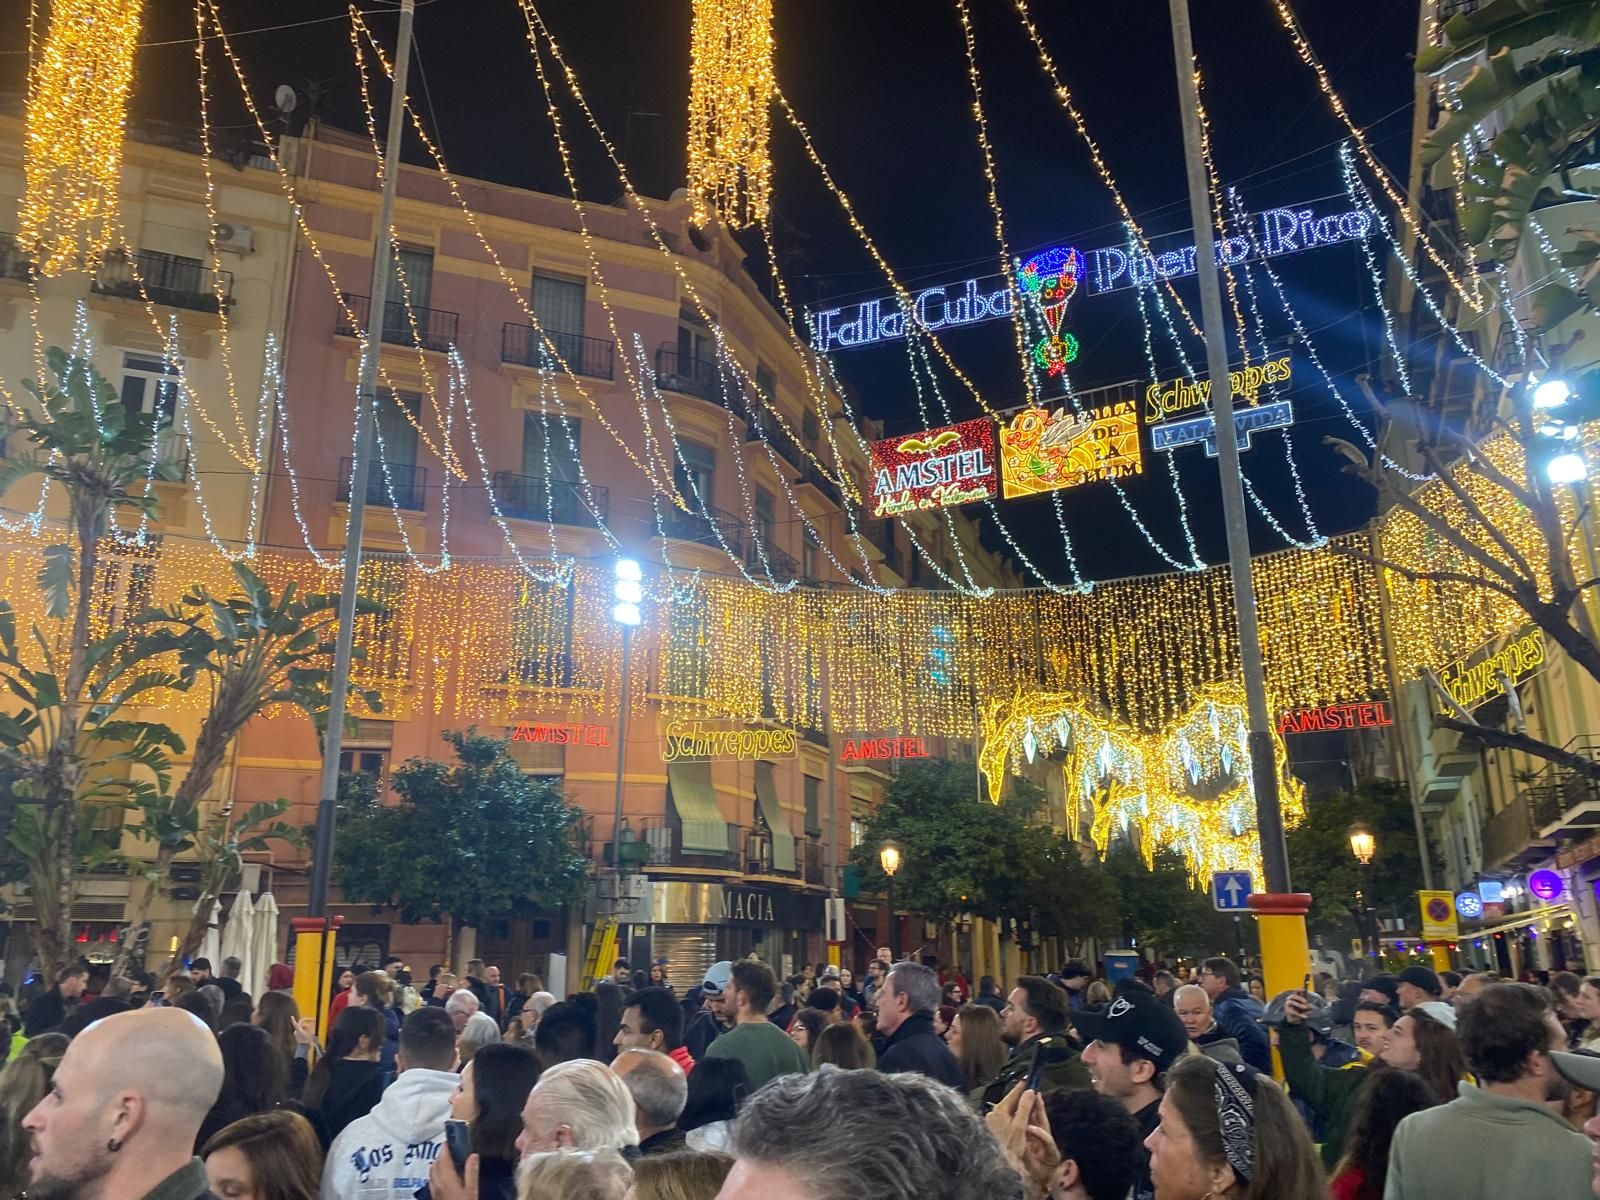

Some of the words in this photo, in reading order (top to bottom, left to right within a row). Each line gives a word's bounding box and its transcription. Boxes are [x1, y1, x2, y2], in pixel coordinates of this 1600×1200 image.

[1263, 207, 1372, 255] Rico
[817, 297, 904, 352] Falla
[912, 278, 1014, 331] Cuba
[1145, 356, 1291, 424] Schwppes
[1073, 401, 1137, 425] FALLA
[1234, 408, 1288, 432] VIDA
[1093, 424, 1120, 441] DE
[1094, 444, 1121, 462] LA
[873, 447, 993, 496] AMSTEL
[1435, 628, 1545, 719] Schweppes
[512, 720, 611, 747] AMSTEL
[1276, 702, 1393, 734] AMSTEL
[662, 721, 797, 762] Schweppes
[840, 736, 930, 760] AMSTEL
[350, 1145, 393, 1184] Los
